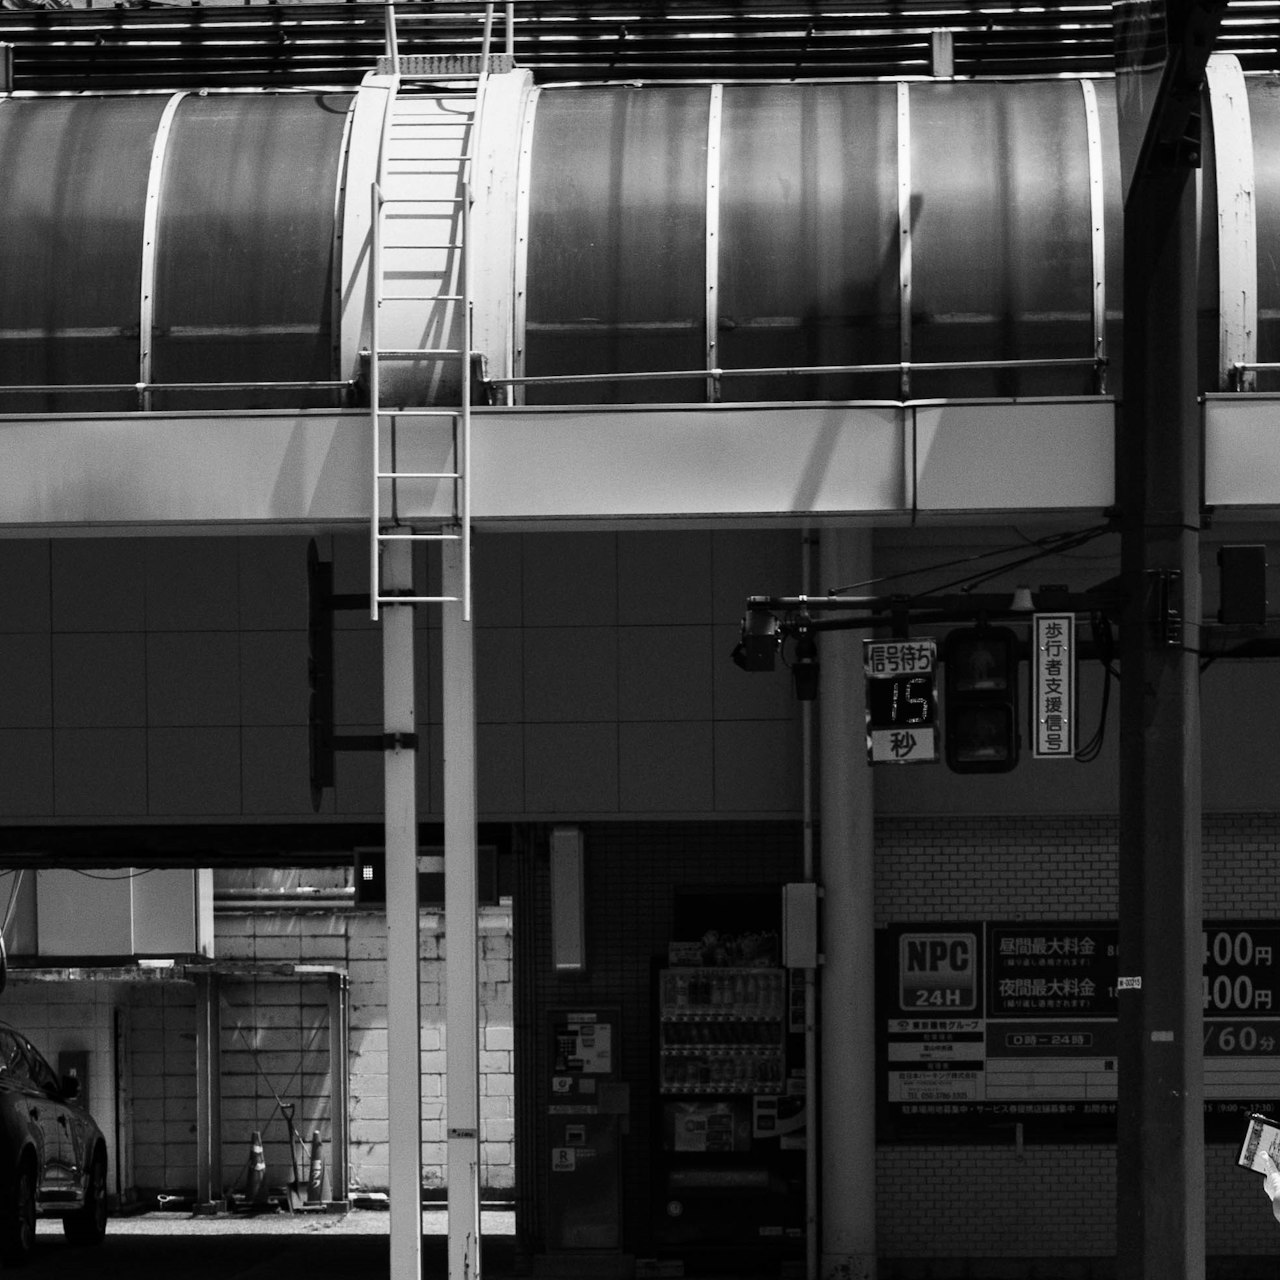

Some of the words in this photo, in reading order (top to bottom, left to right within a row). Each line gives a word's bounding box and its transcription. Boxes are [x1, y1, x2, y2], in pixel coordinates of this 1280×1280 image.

[870, 644, 930, 673] 信号待ち
[1045, 622, 1063, 751] 歩行者支援信号
[891, 677, 928, 724] 15
[890, 731, 917, 757] 秒
[908, 940, 969, 972] NPC
[999, 936, 1096, 956] 昼間最大料金
[915, 989, 961, 1006] 24H
[998, 977, 1096, 997] 夜間最大料金
